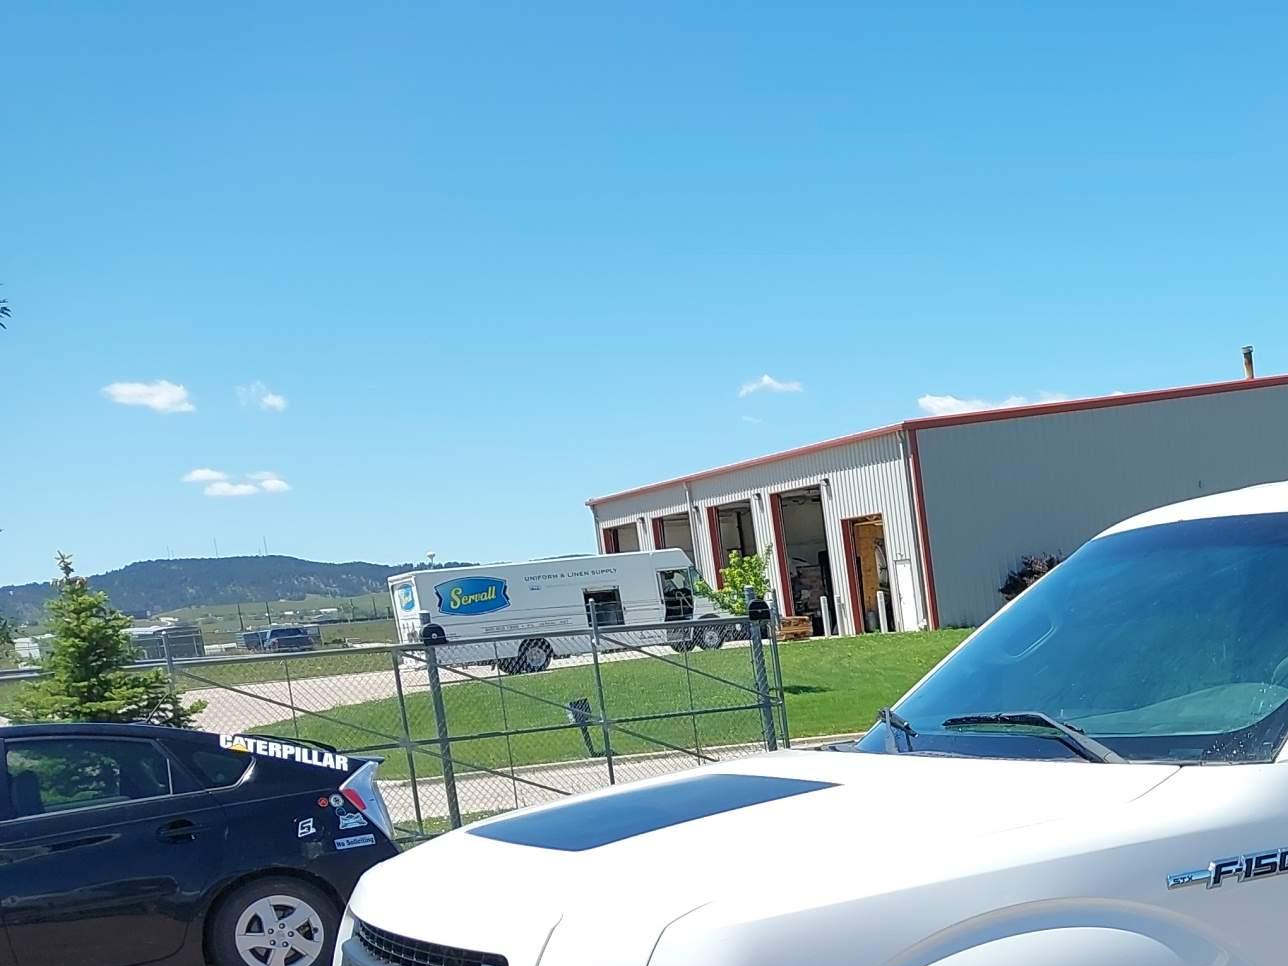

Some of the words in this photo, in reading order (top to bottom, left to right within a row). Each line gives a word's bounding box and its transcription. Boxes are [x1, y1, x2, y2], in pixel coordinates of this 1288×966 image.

[524, 574, 558, 582] UNIFORM
[567, 569, 590, 578] LINEN
[591, 567, 617, 576] SUPPLY
[450, 585, 497, 609] Servall
[219, 734, 349, 772] CATERPILLAR
